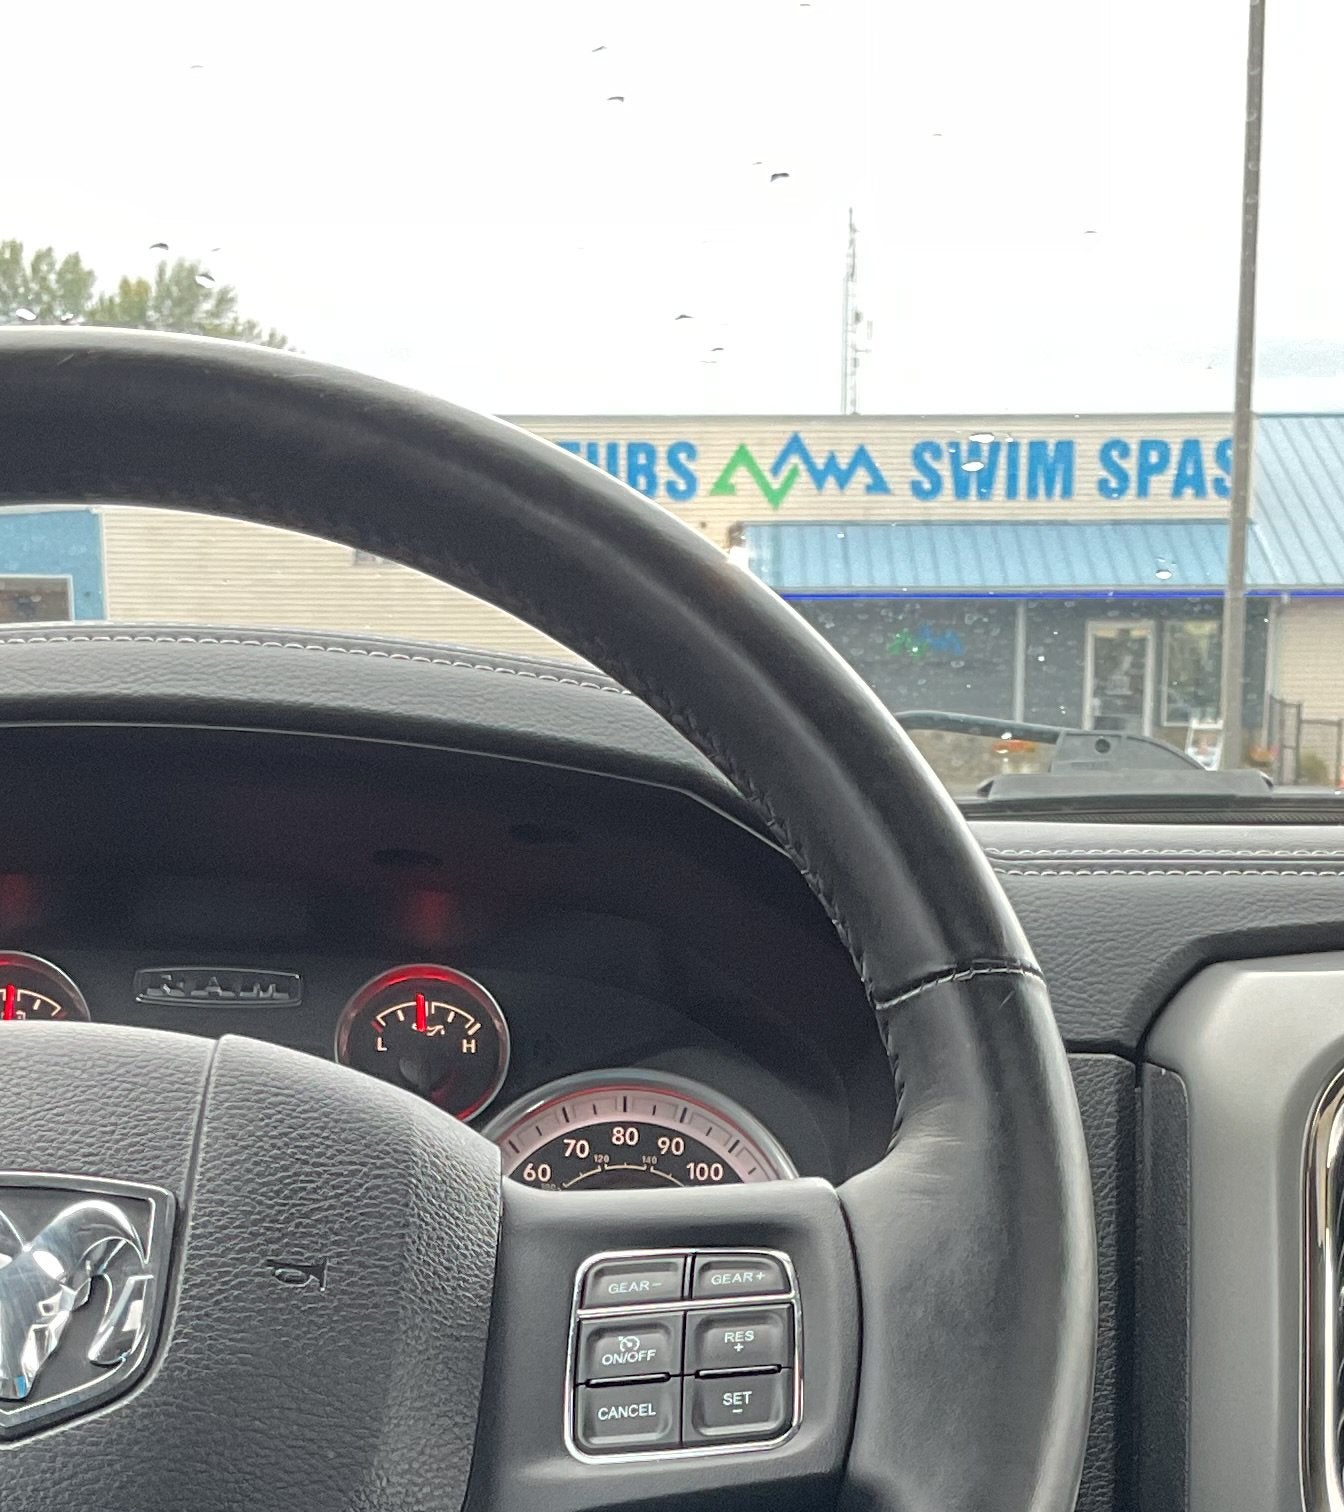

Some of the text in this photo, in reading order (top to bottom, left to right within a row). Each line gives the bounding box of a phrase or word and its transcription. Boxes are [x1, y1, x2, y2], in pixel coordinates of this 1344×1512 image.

[909, 438, 1076, 501] SWIM
[1097, 438, 1233, 500] SPAS
[462, 1039, 476, 1053] H
[611, 1127, 639, 1146] 80
[657, 1136, 685, 1155] 90
[563, 1138, 590, 1158] 70
[523, 1163, 551, 1182] 60
[686, 1162, 724, 1181] 100
[723, 1330, 755, 1344] RES
[602, 1349, 657, 1366] ON/OFF
[722, 1391, 753, 1406] SET
[597, 1403, 657, 1421] CANCEL
